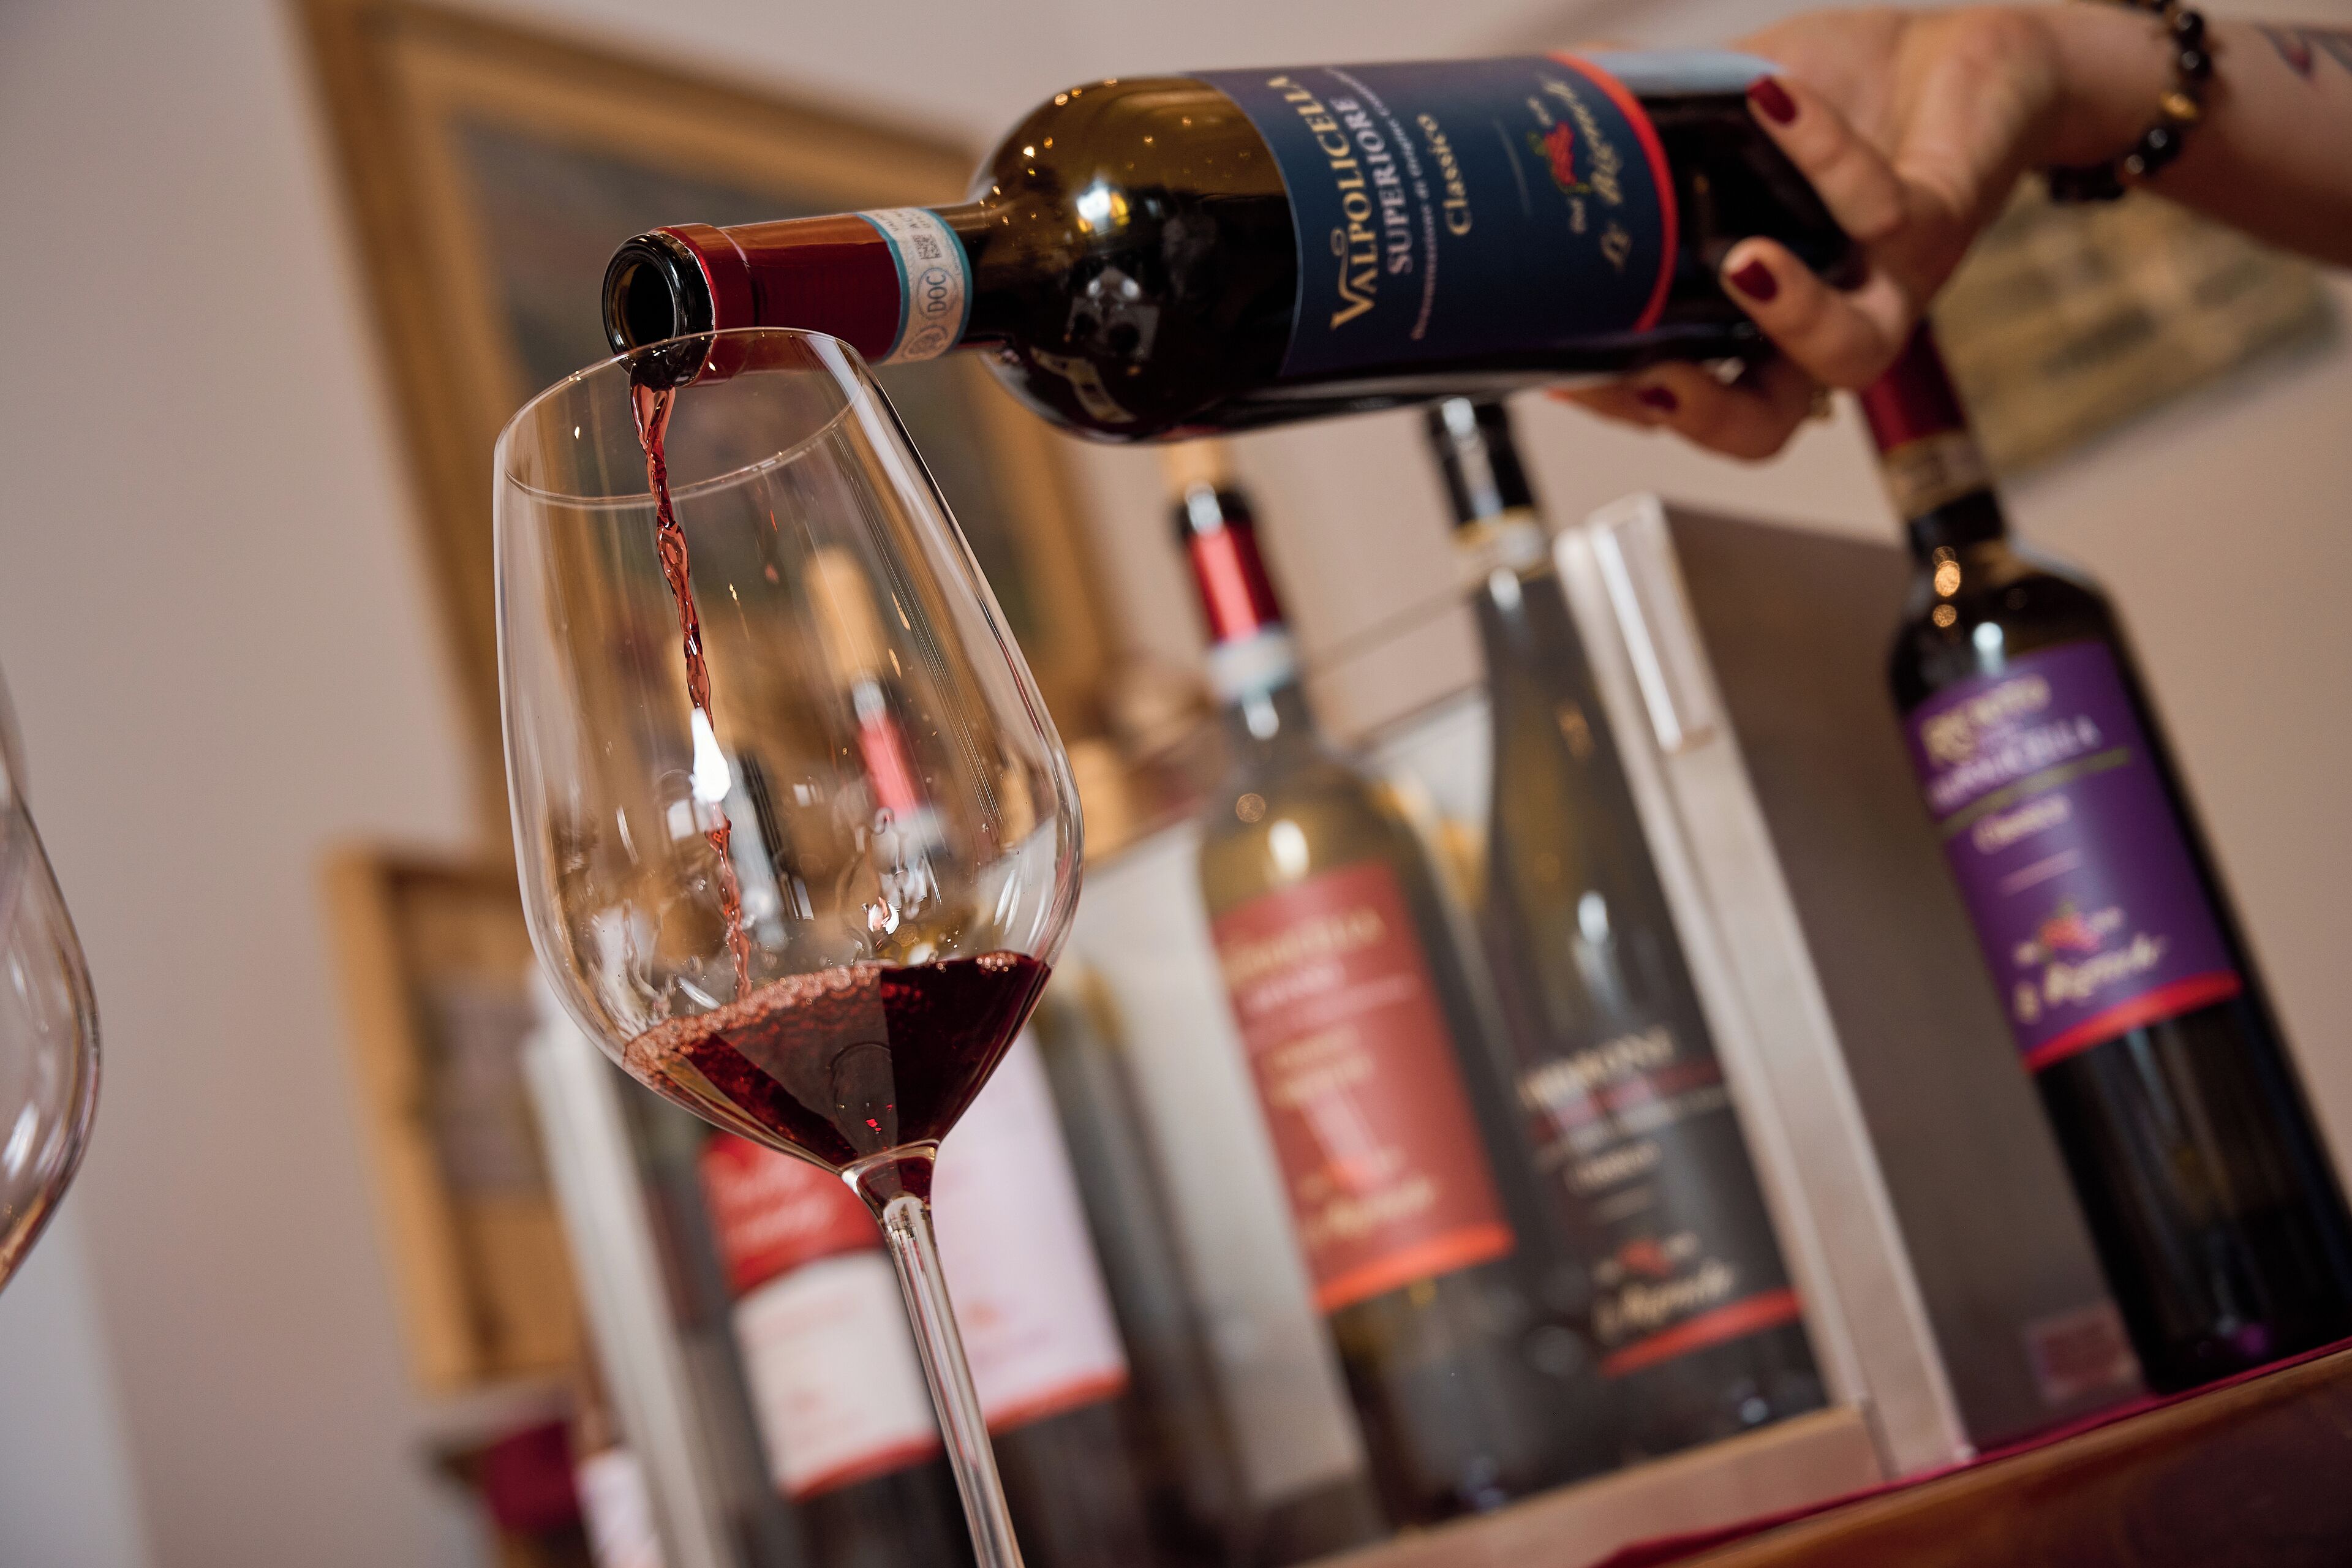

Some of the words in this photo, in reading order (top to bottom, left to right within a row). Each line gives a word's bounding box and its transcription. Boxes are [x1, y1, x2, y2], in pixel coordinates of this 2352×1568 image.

[1267, 75, 1378, 330] VALPOLICELLA
[1330, 98, 1413, 274] SUPERIORE
[1416, 112, 1473, 236] Classico
[925, 274, 948, 313] DOC
